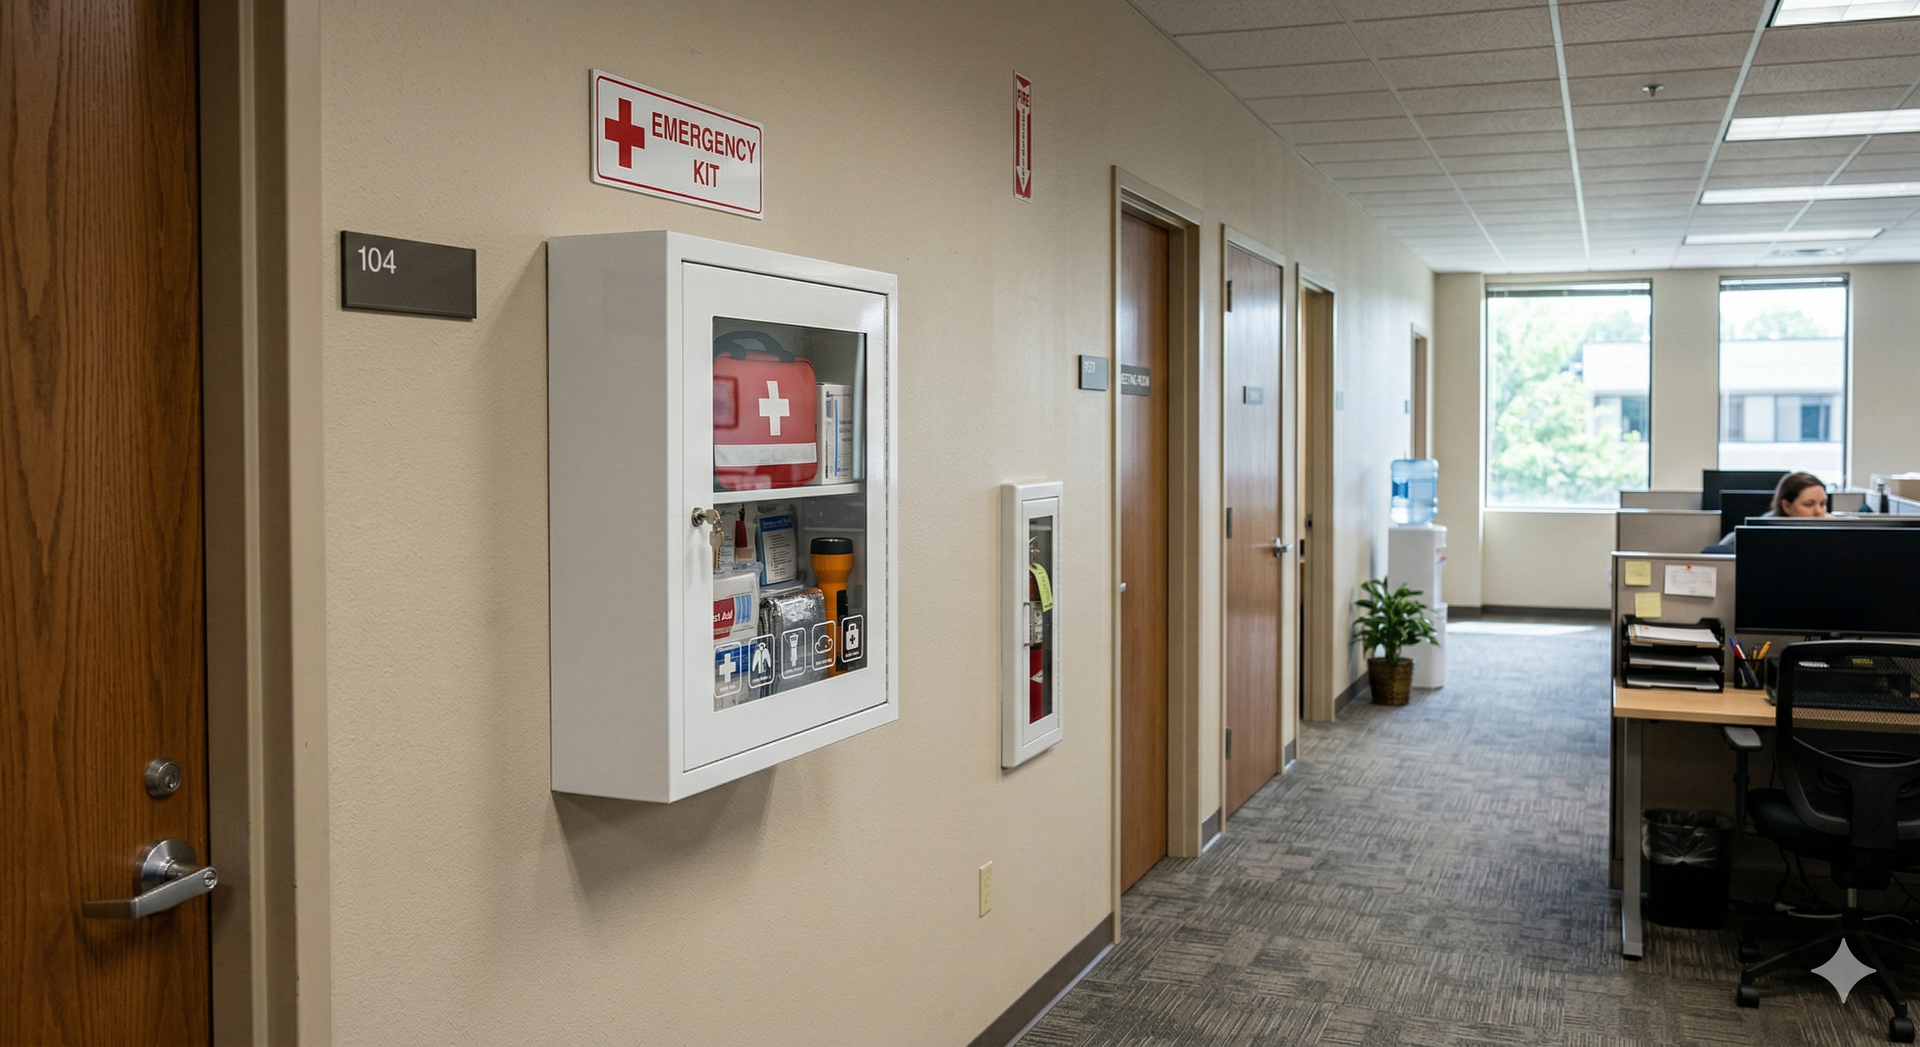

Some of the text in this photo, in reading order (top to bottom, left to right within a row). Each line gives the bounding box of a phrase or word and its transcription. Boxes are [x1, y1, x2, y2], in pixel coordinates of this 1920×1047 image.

[652, 111, 757, 164] EMERGENCY
[693, 159, 720, 188] KIT
[357, 245, 397, 275] 104
